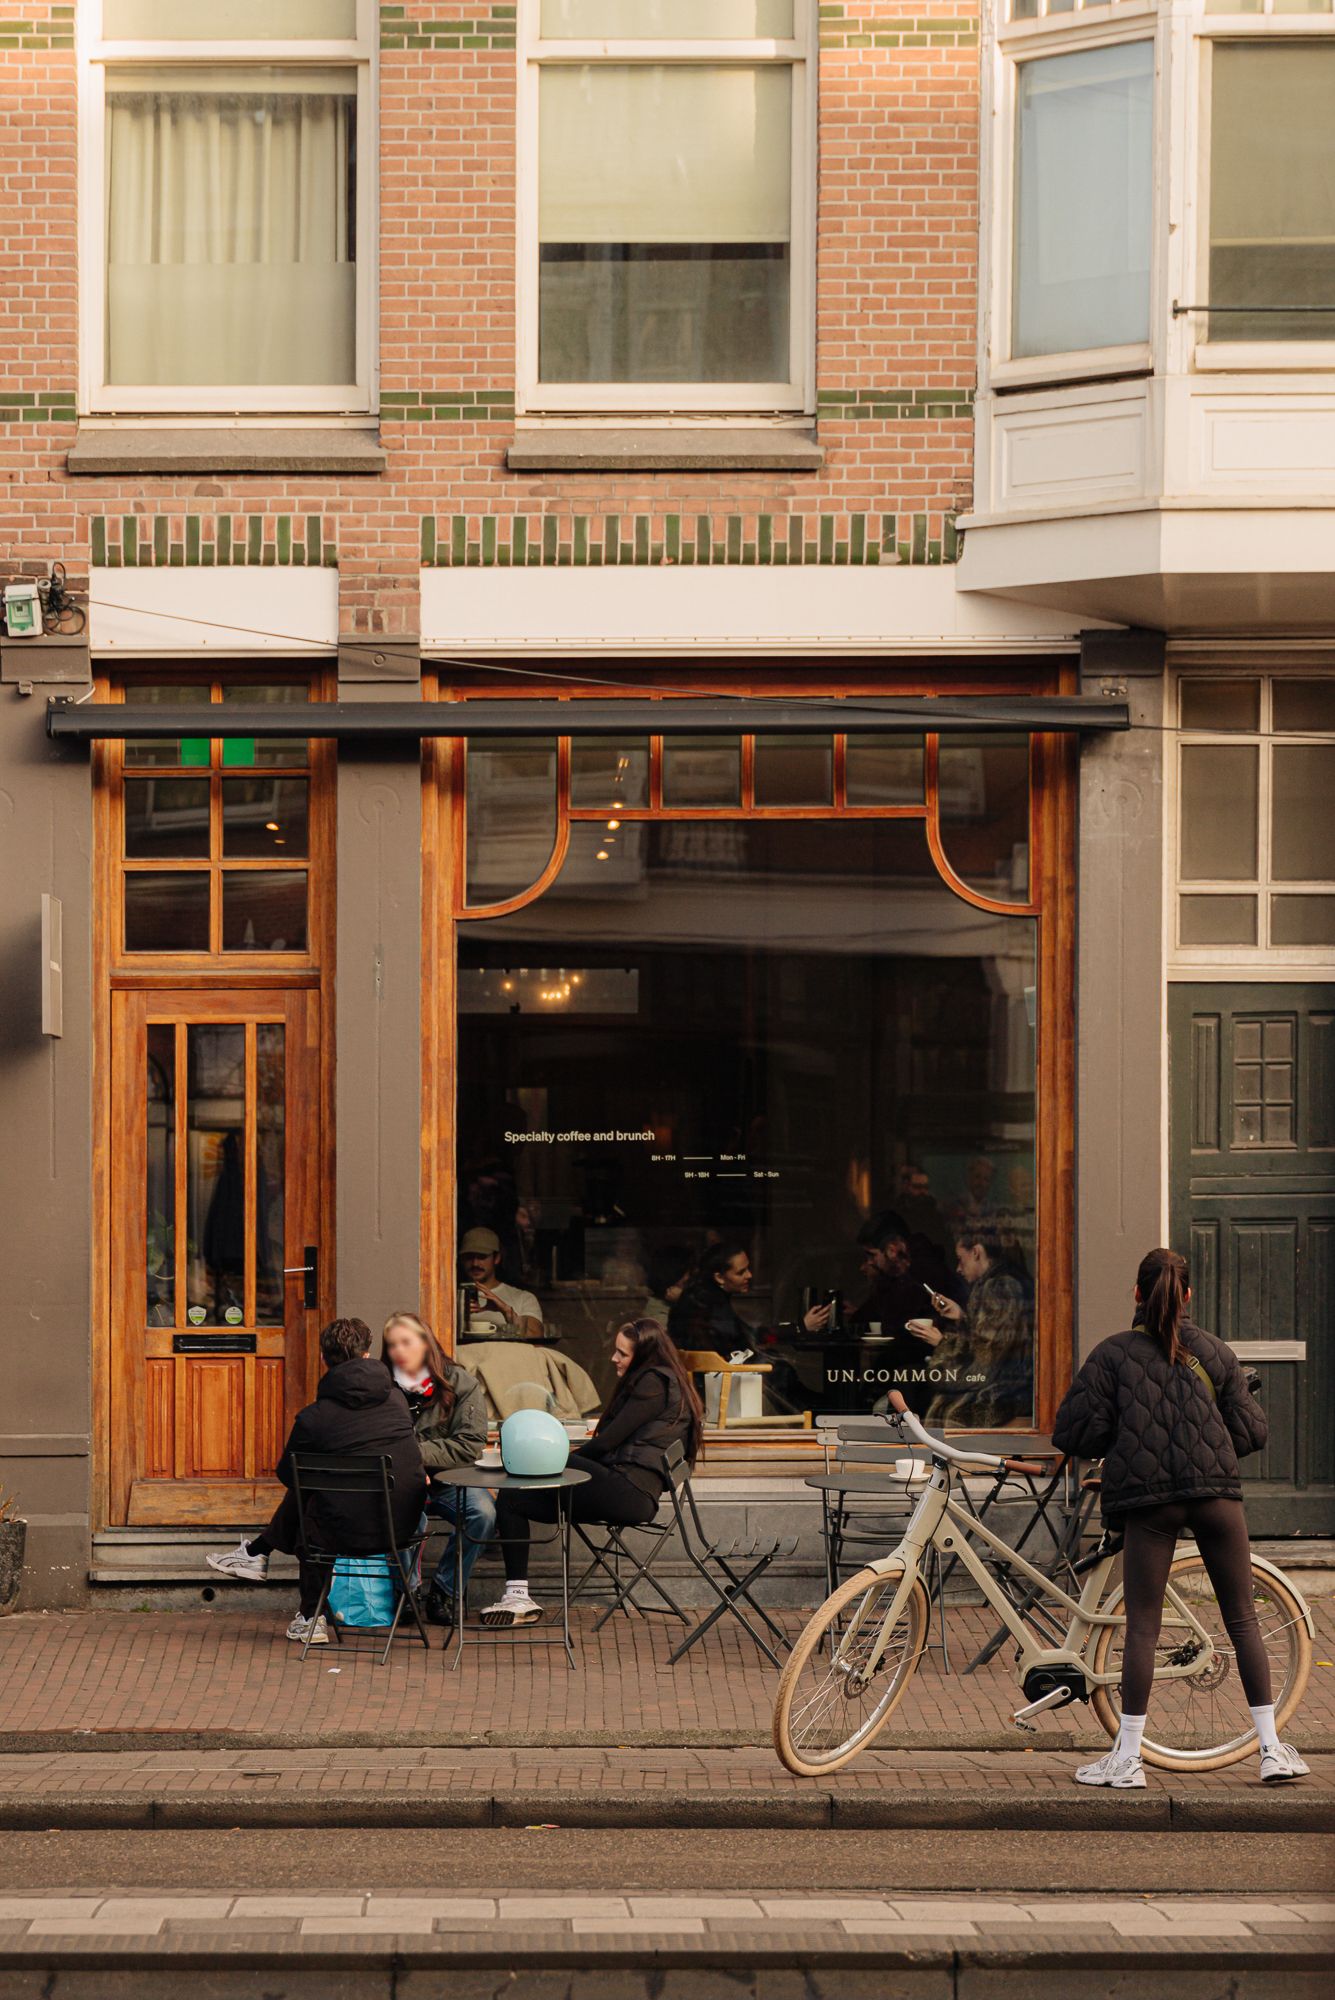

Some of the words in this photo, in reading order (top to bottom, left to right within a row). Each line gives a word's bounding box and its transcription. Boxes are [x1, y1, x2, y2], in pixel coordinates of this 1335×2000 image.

[504, 1131, 555, 1144] Specialty
[556, 1130, 592, 1142] coffee
[593, 1130, 614, 1141] and
[616, 1130, 655, 1141] brunch
[827, 1369, 958, 1382] UN.COMMON
[965, 1373, 986, 1382] cafe
